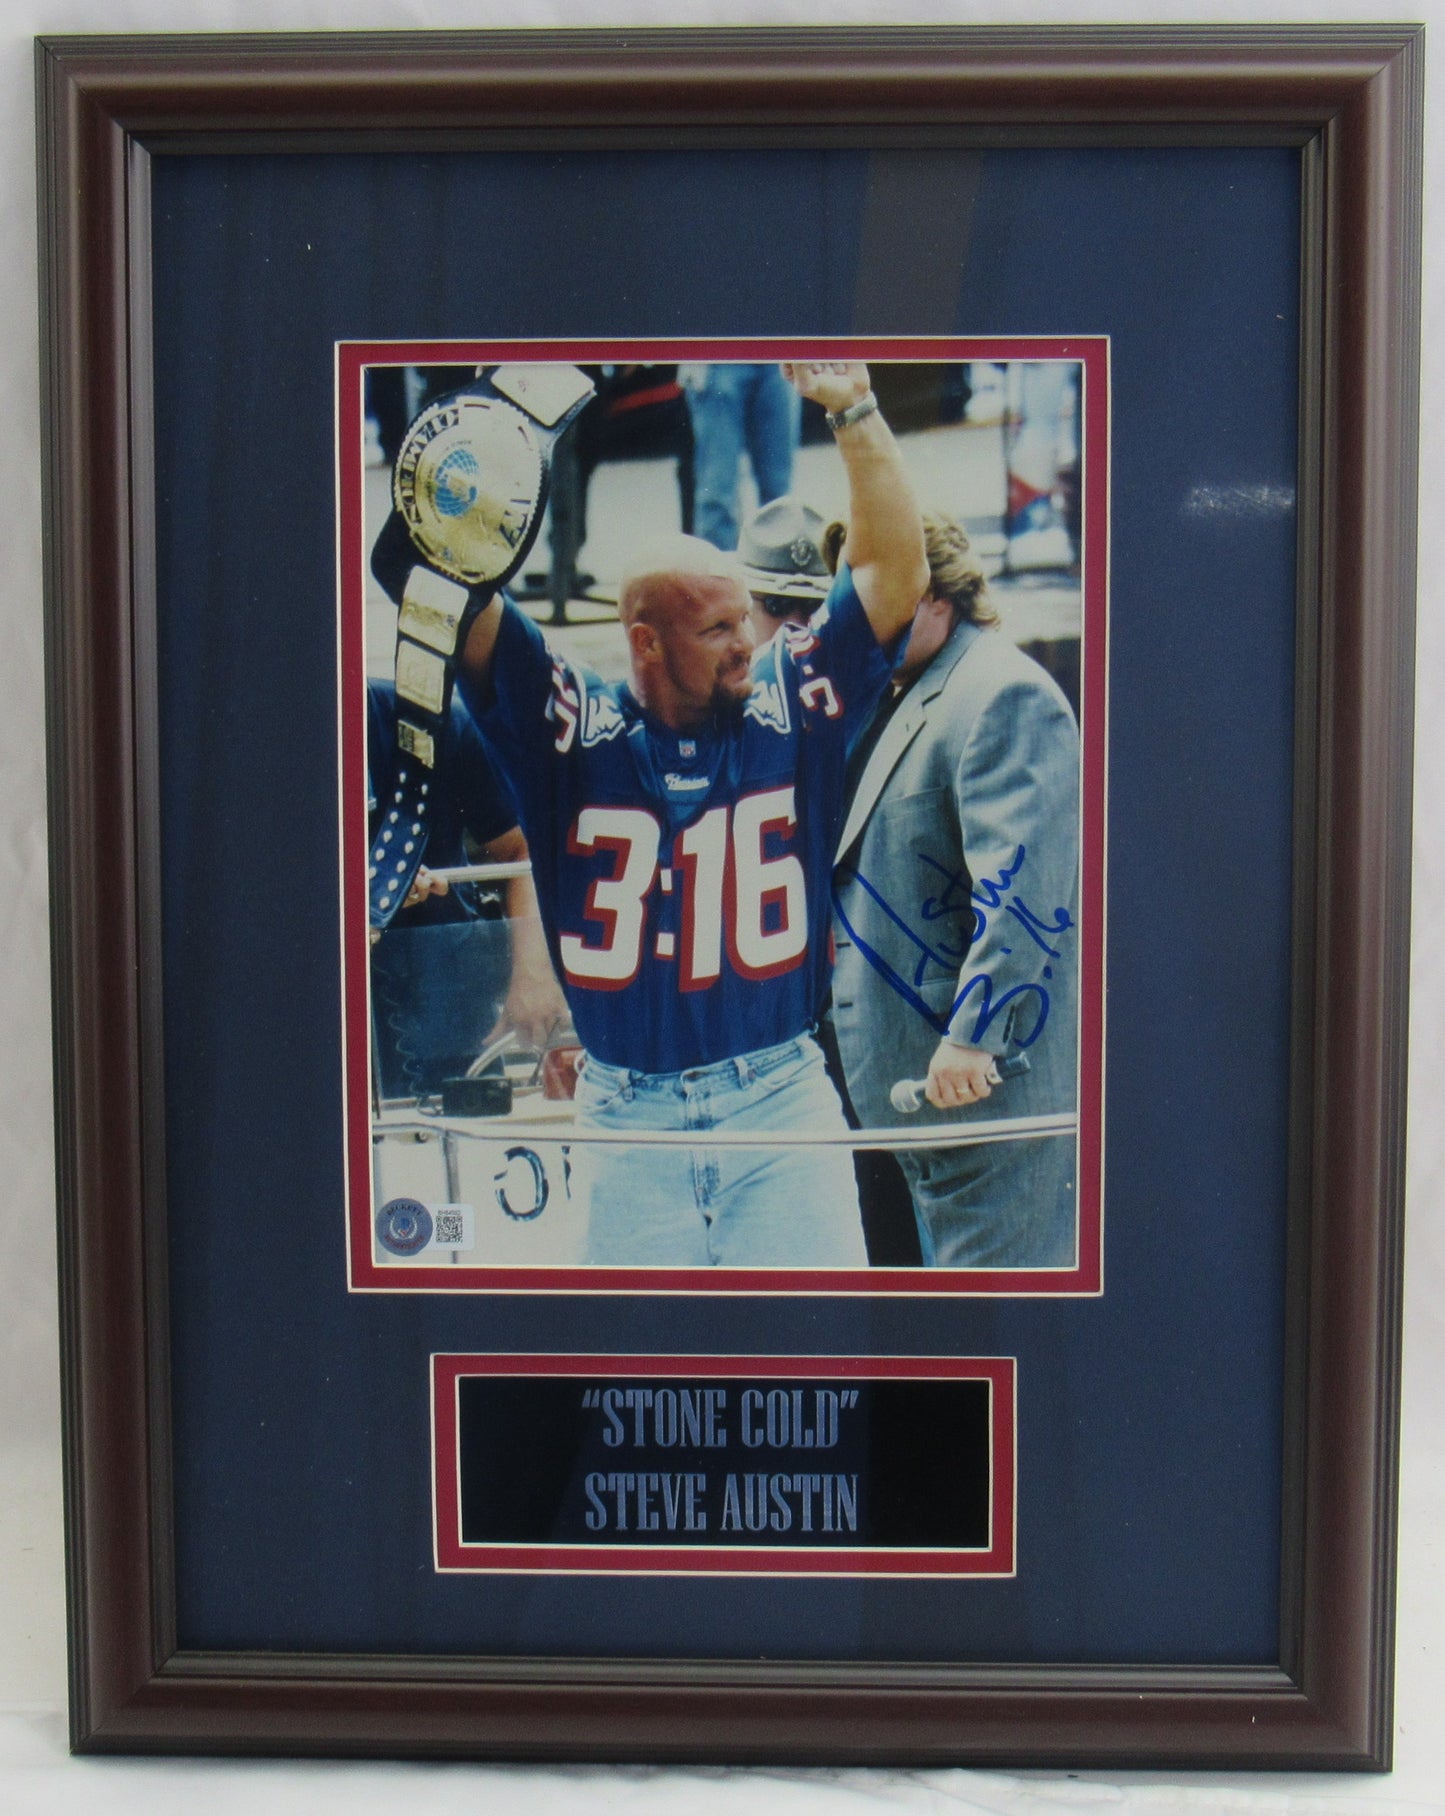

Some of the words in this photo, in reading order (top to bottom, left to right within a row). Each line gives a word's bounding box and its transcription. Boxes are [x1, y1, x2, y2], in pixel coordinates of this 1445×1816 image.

[558, 784, 809, 994] 3:16
[584, 1472, 707, 1532] STEVE
[719, 1473, 858, 1532] AUSTIN
